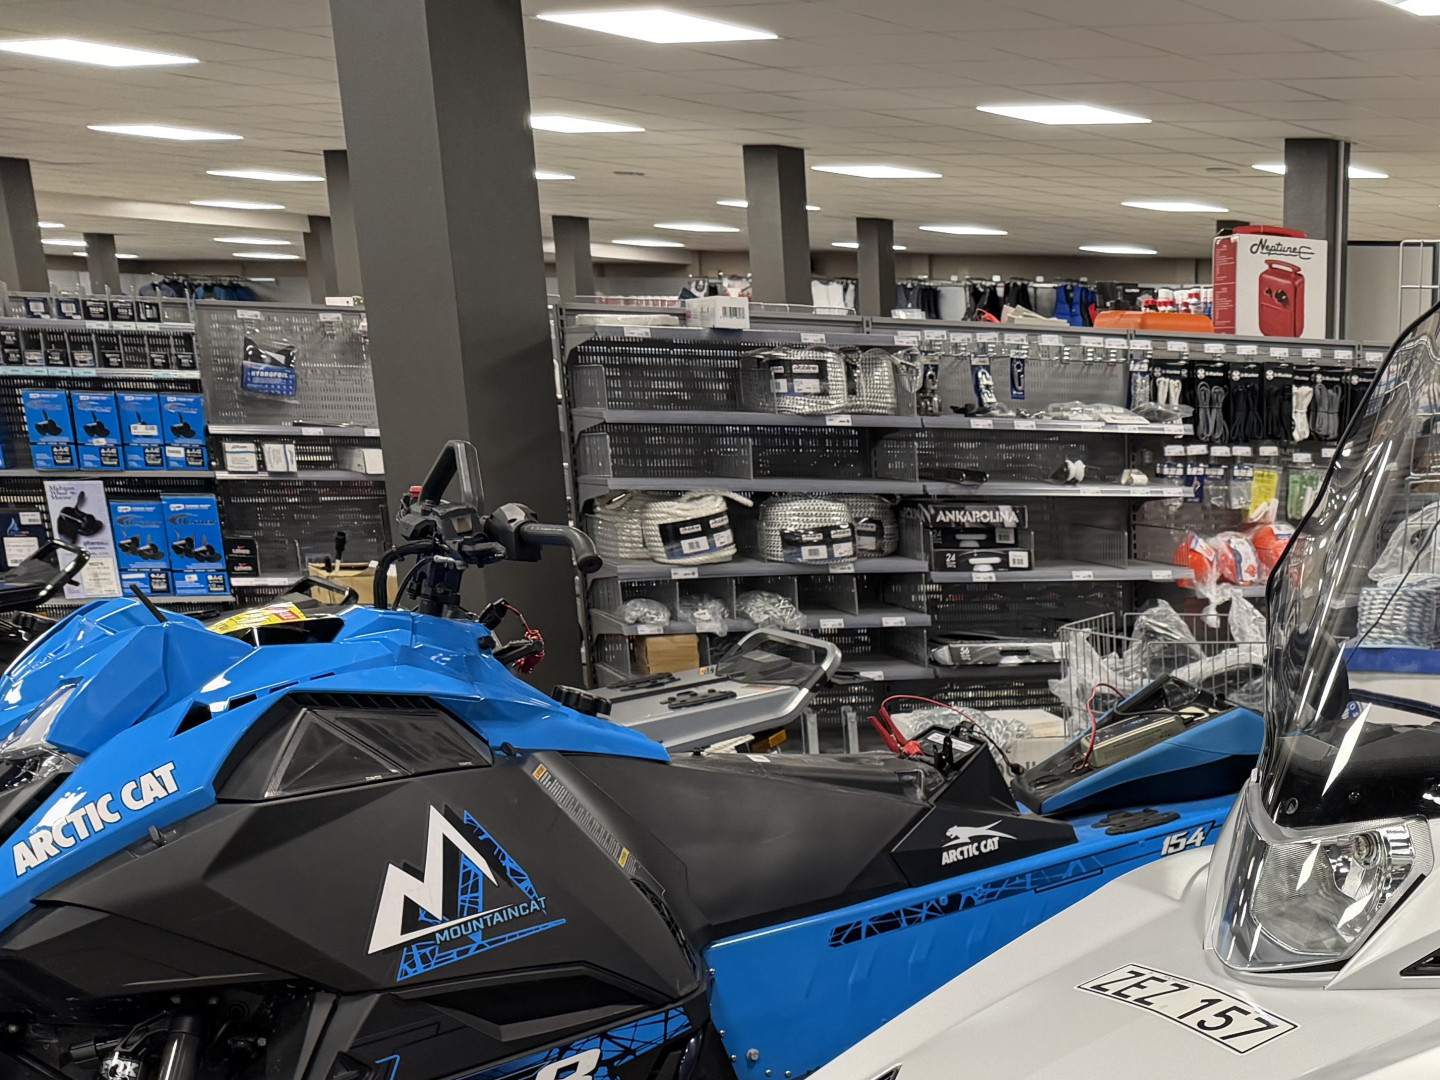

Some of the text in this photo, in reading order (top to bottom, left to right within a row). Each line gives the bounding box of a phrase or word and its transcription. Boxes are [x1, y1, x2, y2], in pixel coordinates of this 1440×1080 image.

[1249, 238, 1300, 256] Neptune
[935, 509, 1020, 523] ANKAROLINA
[945, 553, 957, 562] 24
[11, 760, 180, 878] ARCTIC CAT
[941, 835, 1001, 867] ARCTIC CAT
[1159, 826, 1206, 857] 154
[434, 895, 548, 946] MOUNTAINCAT
[1090, 970, 1280, 1041] ZEZ 157
